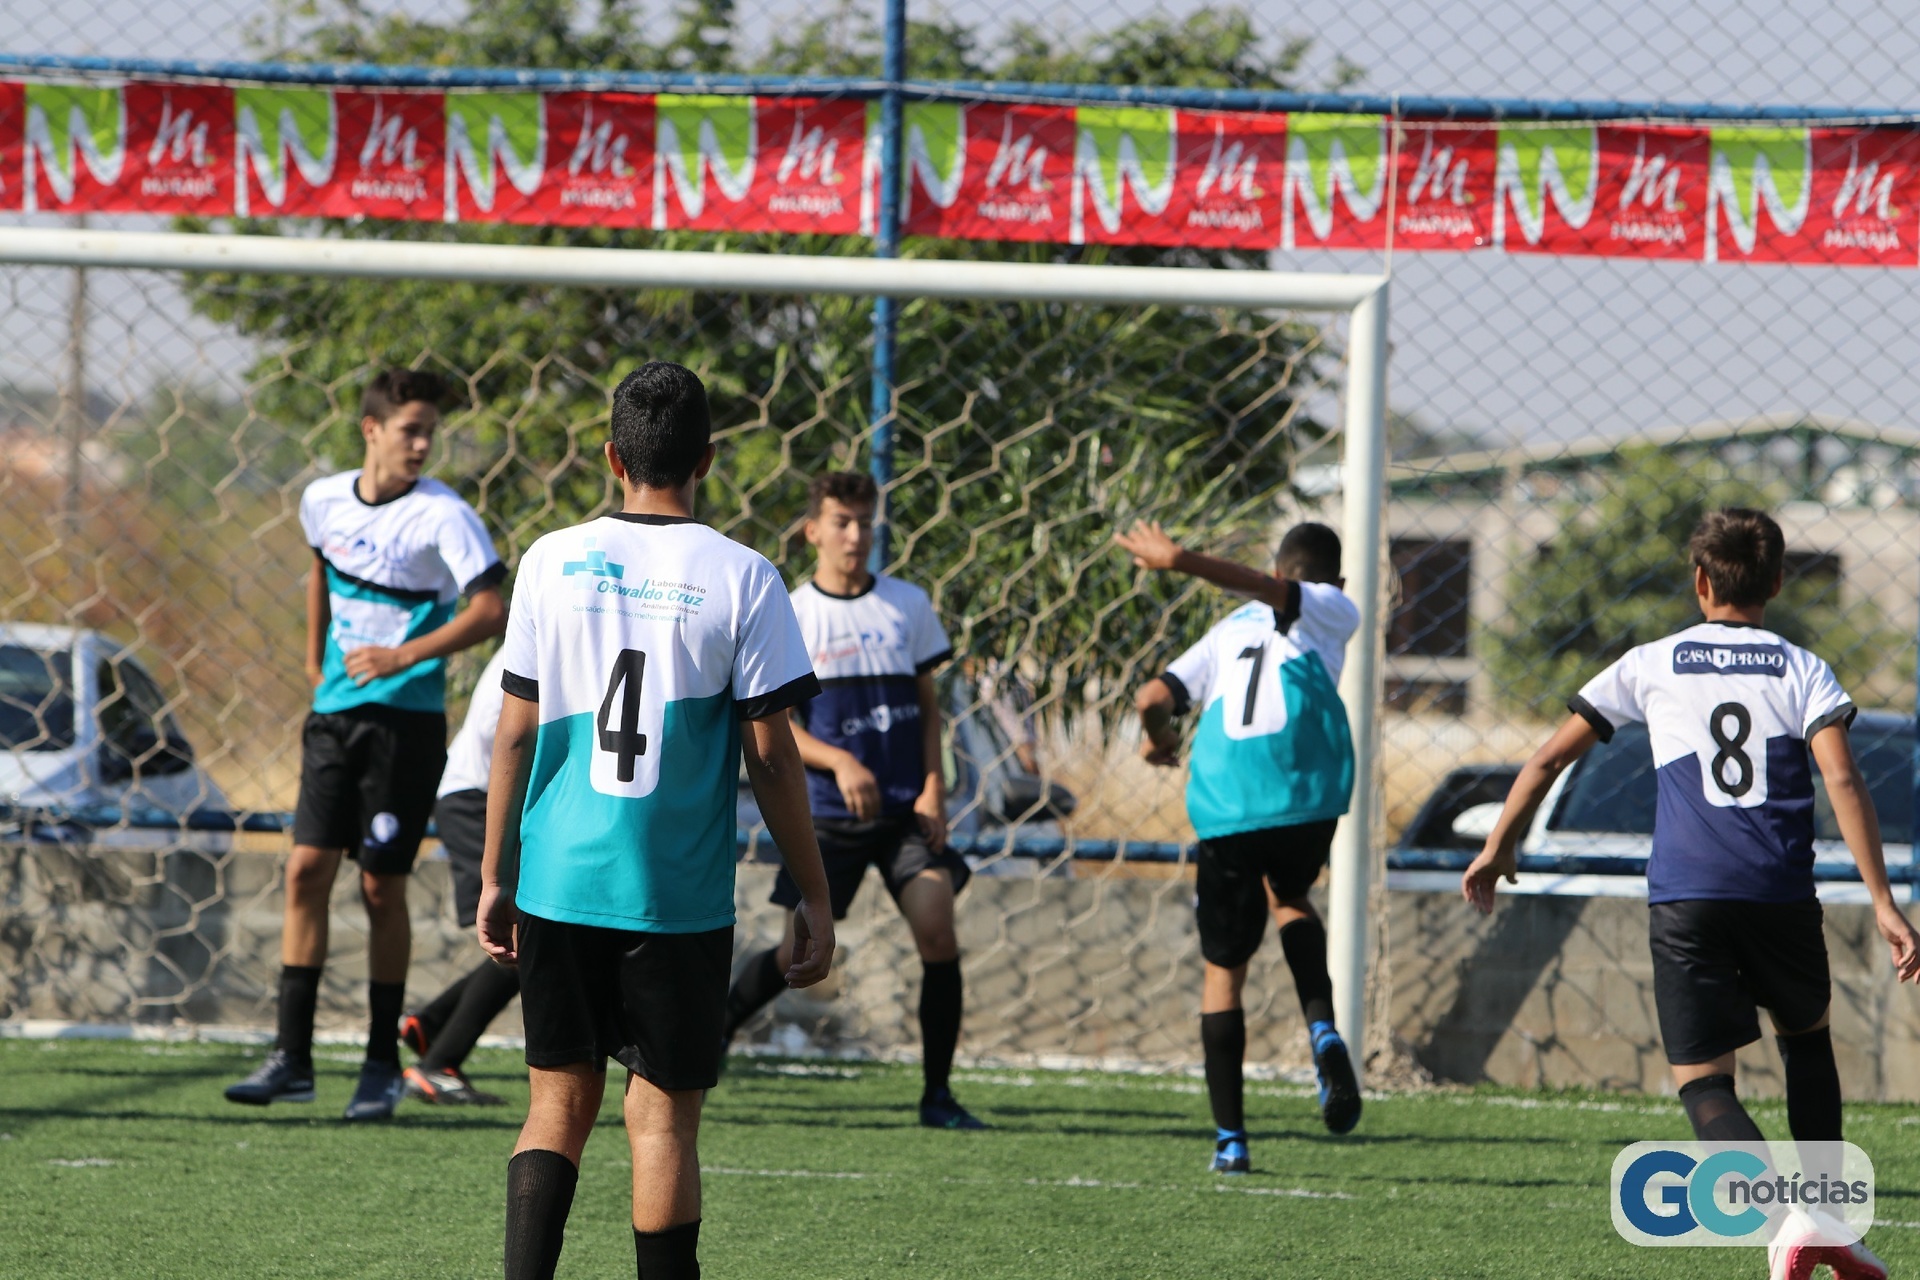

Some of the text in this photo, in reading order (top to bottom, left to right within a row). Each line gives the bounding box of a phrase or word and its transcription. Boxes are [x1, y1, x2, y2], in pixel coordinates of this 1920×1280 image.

[597, 578, 704, 607] Oswaldo Cruz
[651, 579, 707, 594] Laboratório
[585, 605, 606, 614] saúde
[1675, 649, 1785, 669] CASA PRADO
[597, 648, 647, 783] 4
[1709, 701, 1754, 798] 8
